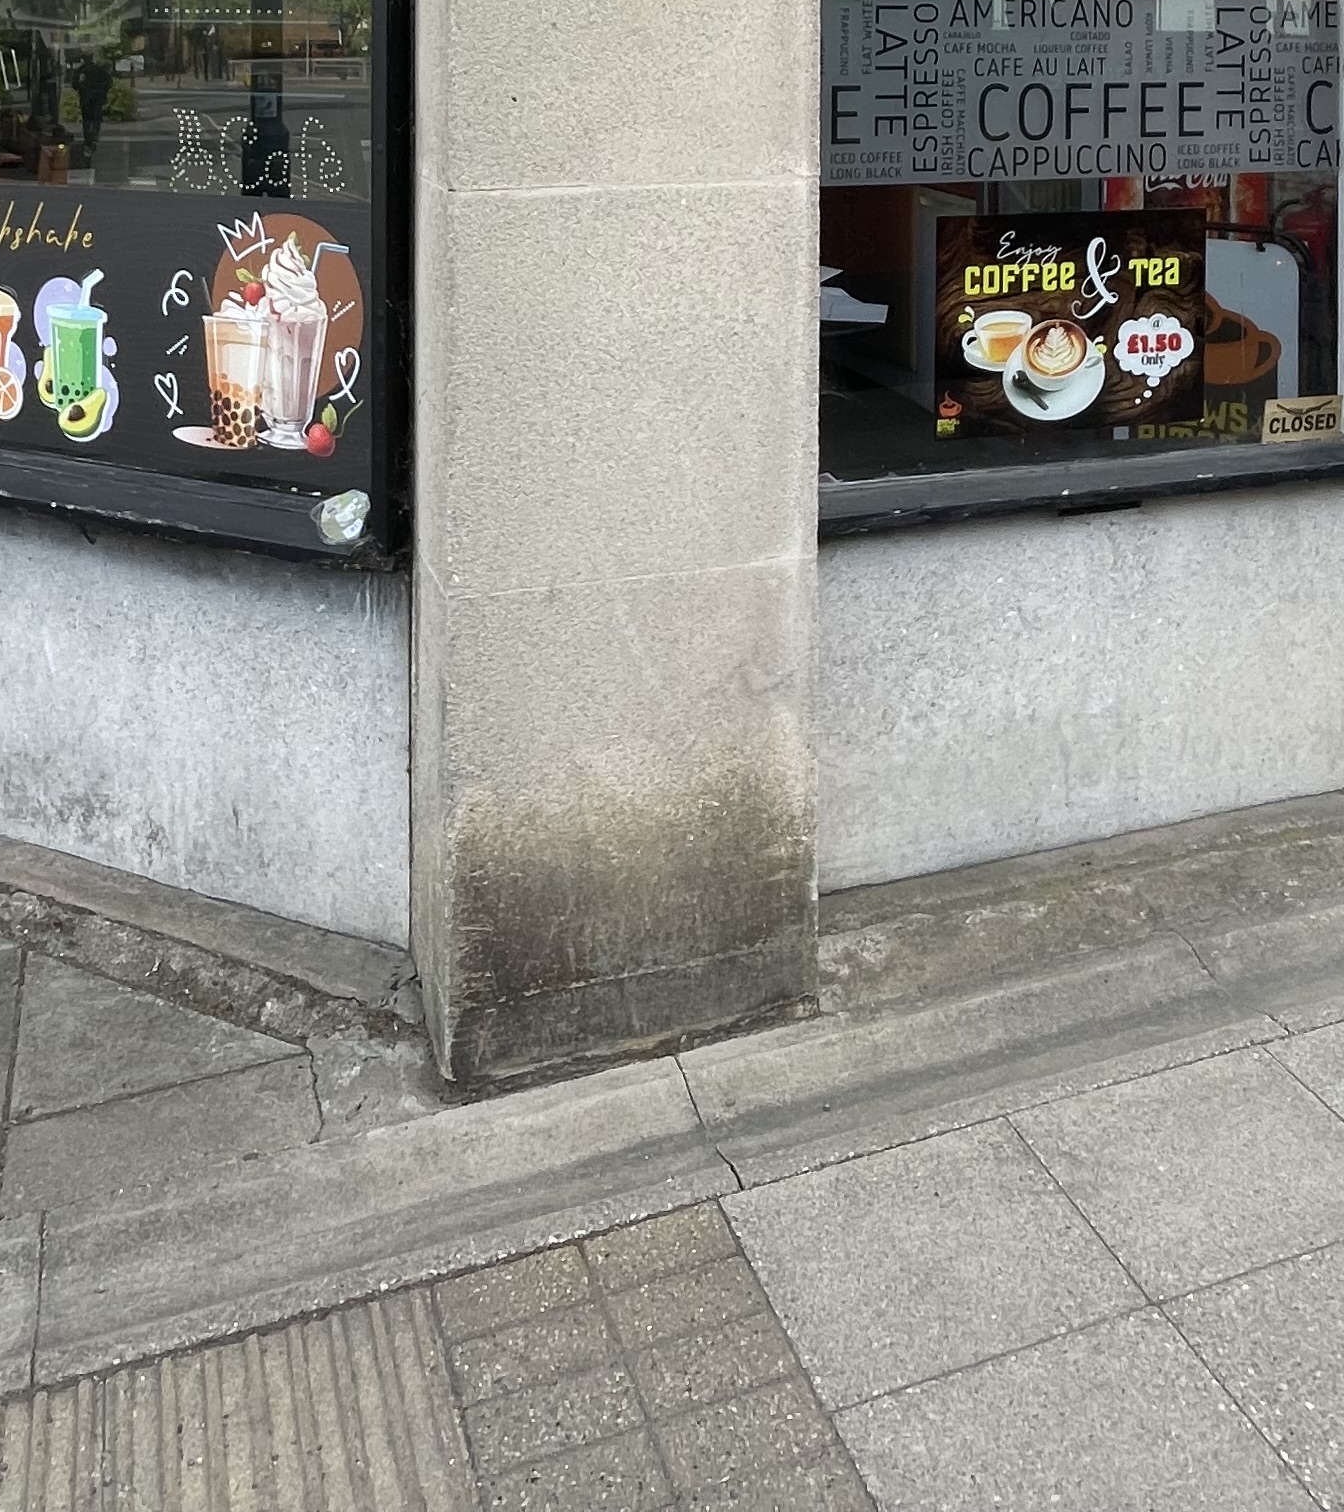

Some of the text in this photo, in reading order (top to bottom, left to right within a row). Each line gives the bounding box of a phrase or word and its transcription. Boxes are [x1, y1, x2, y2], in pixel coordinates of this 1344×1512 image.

[861, 0, 873, 75] FLAT WHITE
[943, 43, 1017, 54] CAFE MOCHA
[1033, 44, 1109, 54] LIQUEUR COFFEE
[1069, 31, 1111, 41] CORTADO
[1275, 42, 1301, 53] CAFE
[874, 4, 909, 136] LATTE
[974, 56, 1107, 77] CAFE AU LAIT
[1164, 36, 1174, 74] VIENNA
[1205, 45, 1215, 73] FLAT
[1216, 7, 1246, 130] LATTE
[912, 3, 939, 173] ESPRESSO
[1249, 6, 1272, 163] ESPRESSO
[941, 68, 954, 176] IRISH COFFEE
[956, 68, 966, 176] CAFFE MACCHIATO
[978, 81, 1205, 142] COFFEE
[1273, 66, 1286, 166] IRISH COFFEE
[830, 150, 903, 165] ICED COFFEE
[967, 143, 1167, 178] CAPPUCCINO
[1177, 142, 1241, 155] ICED COFFEE
[1177, 157, 1240, 170] LONG BLACK
[830, 166, 902, 180] LONG BLACK
[996, 230, 1062, 271] Enjoy
[1071, 236, 1122, 321] &
[1126, 332, 1182, 355] £1.50
[1141, 353, 1166, 370] Only
[1268, 413, 1337, 434] CLOSED
